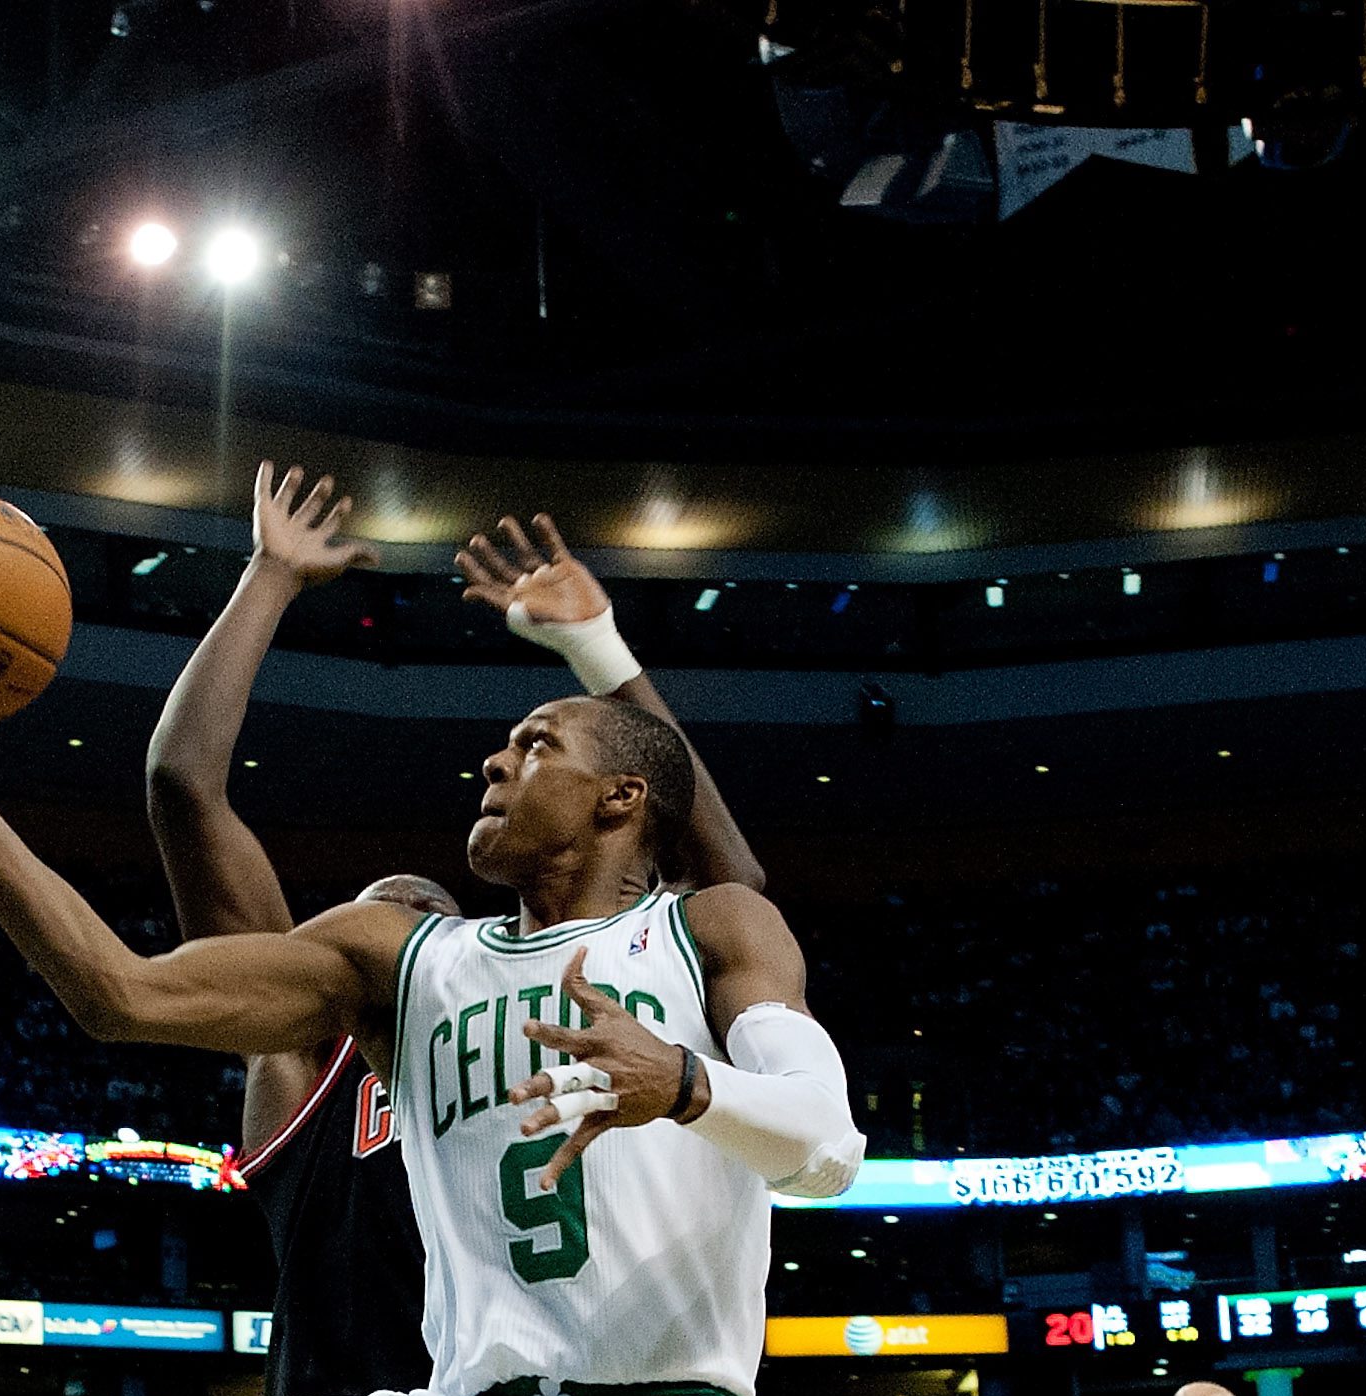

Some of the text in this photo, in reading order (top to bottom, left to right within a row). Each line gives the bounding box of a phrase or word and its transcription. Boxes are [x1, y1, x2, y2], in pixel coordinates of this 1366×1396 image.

[428, 982, 666, 1140] CELTI
[499, 1131, 590, 1285] 9
[1045, 1311, 1094, 1346] 20
